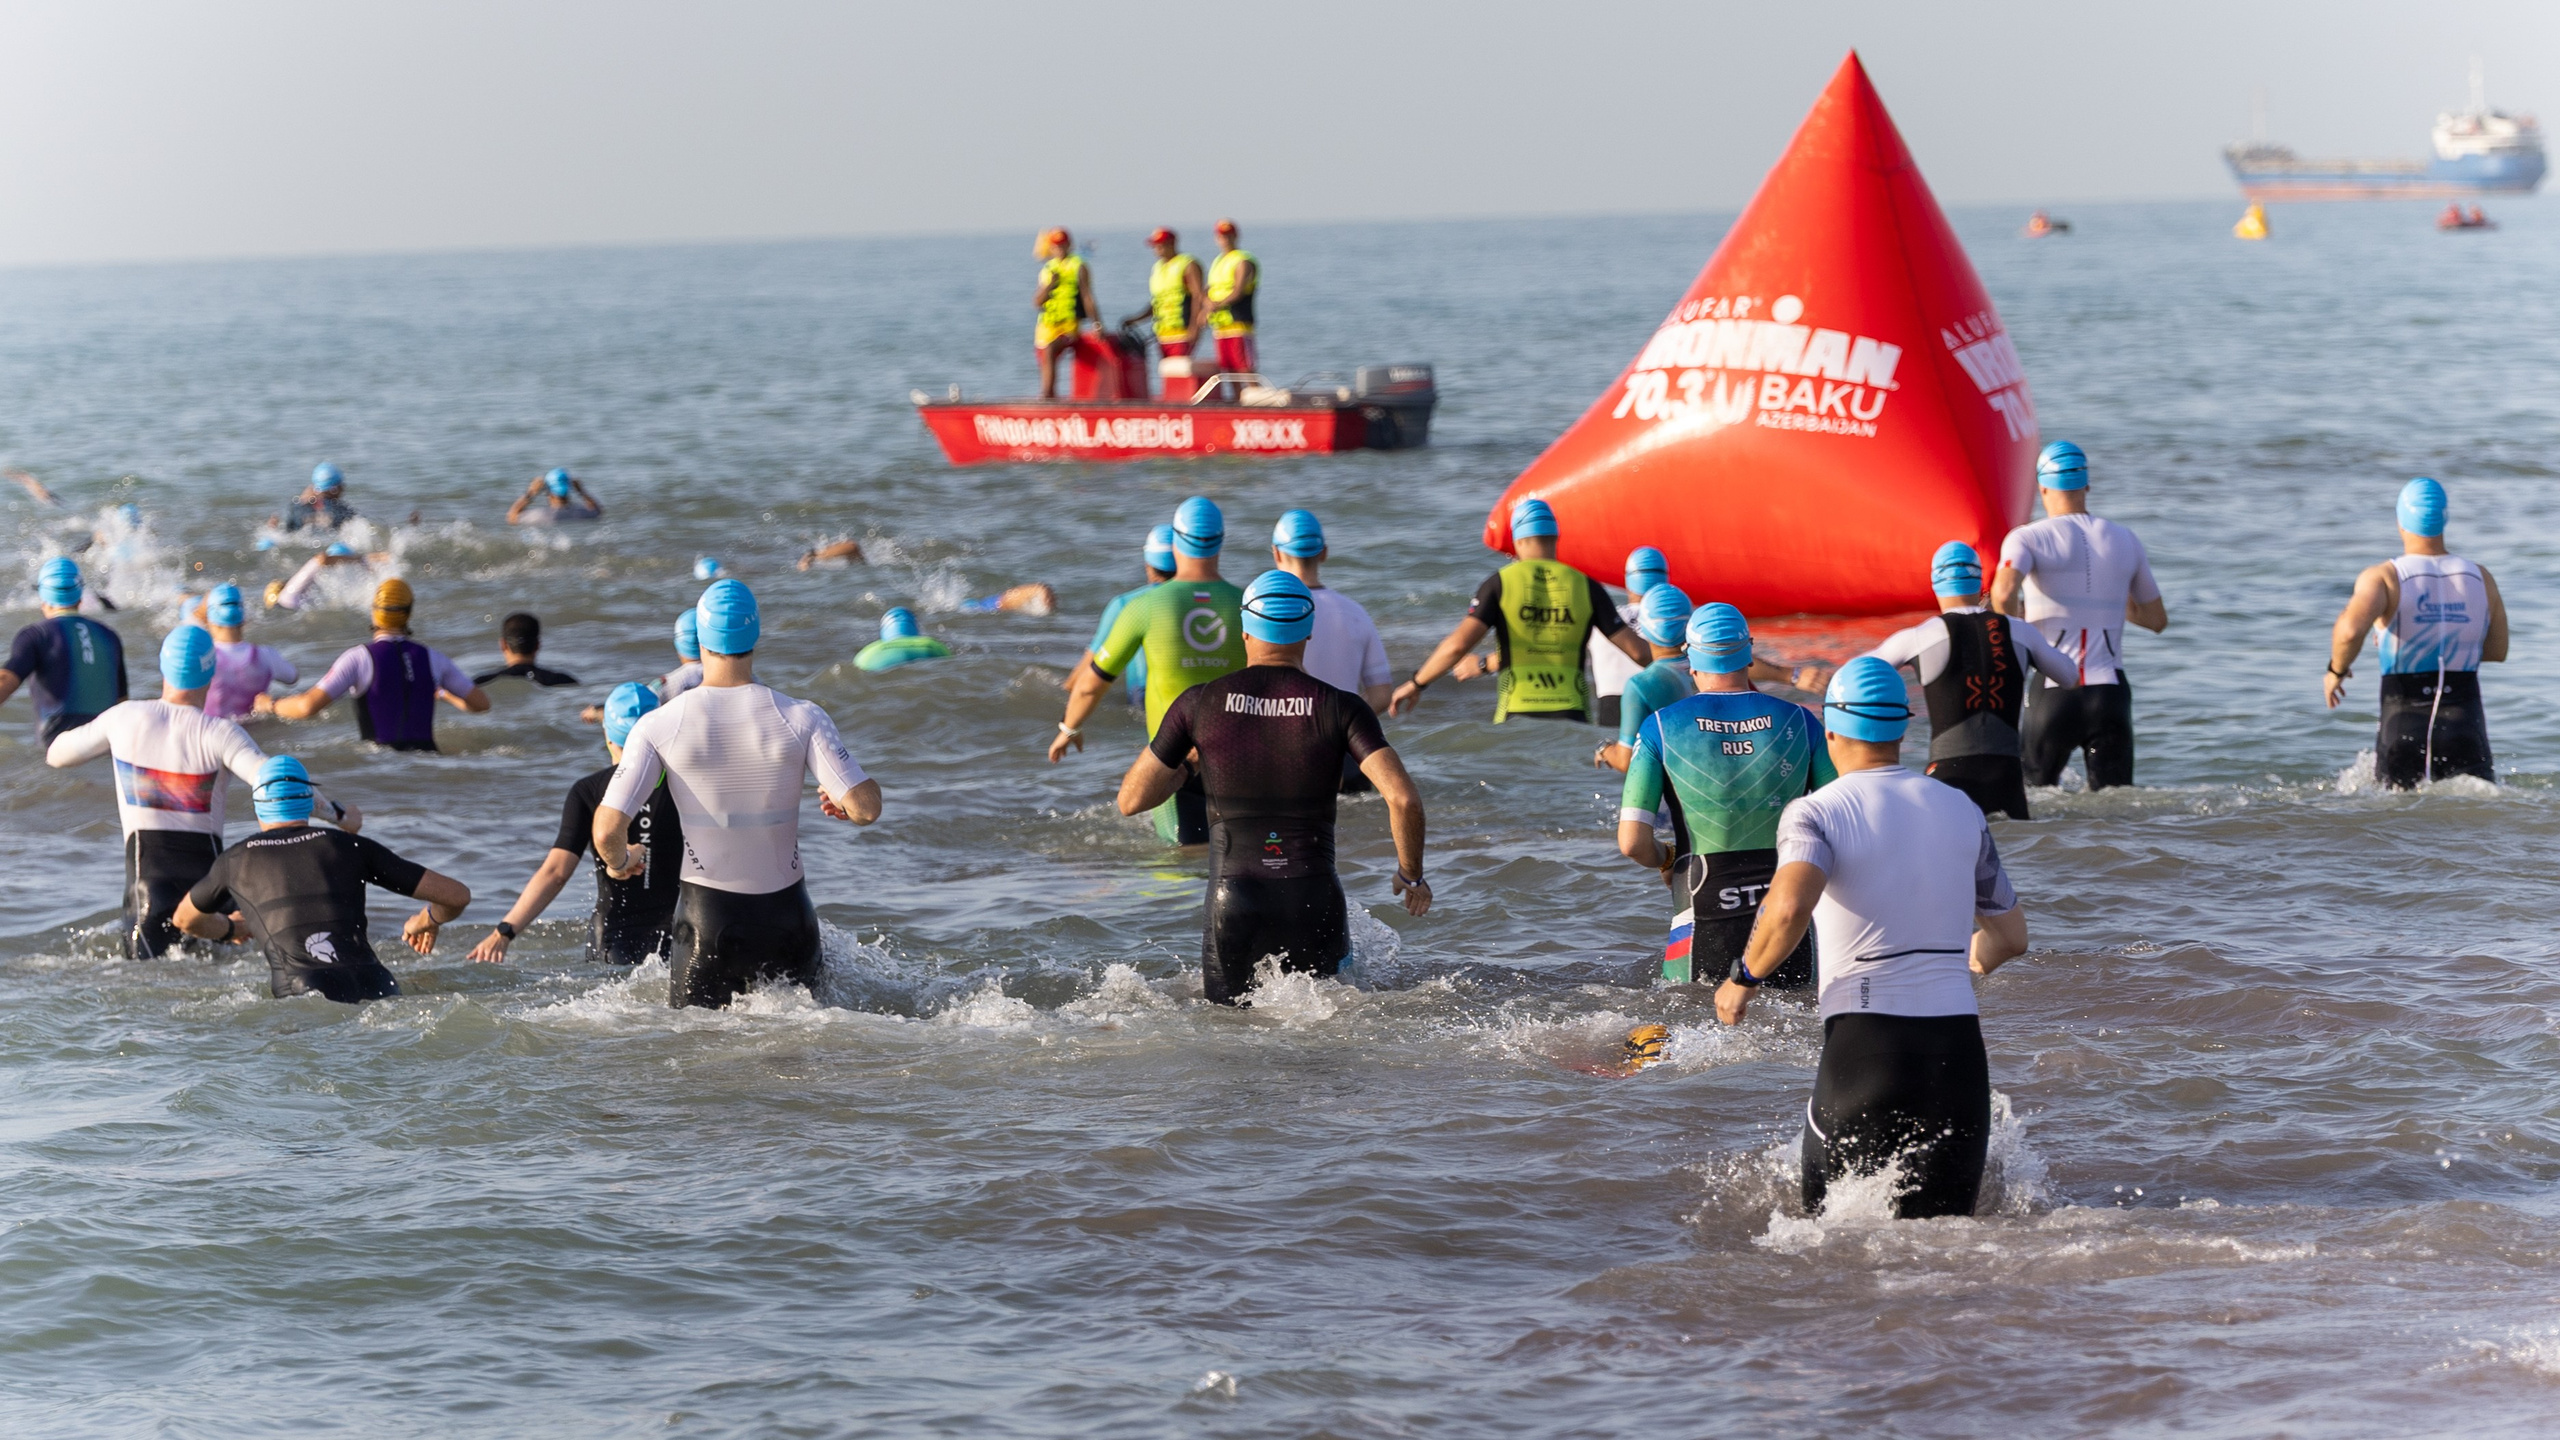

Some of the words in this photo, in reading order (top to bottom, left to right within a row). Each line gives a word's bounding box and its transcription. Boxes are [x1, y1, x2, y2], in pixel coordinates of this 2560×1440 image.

[1635, 318, 1902, 390] IRONMAN
[1758, 373, 1888, 421] BAKU
[1182, 657, 1229, 668] ELTSOV
[1225, 692, 1313, 717] KORKMAZOV
[1695, 715, 1773, 734] TRETYAKOV
[1722, 740, 1754, 755] RUS
